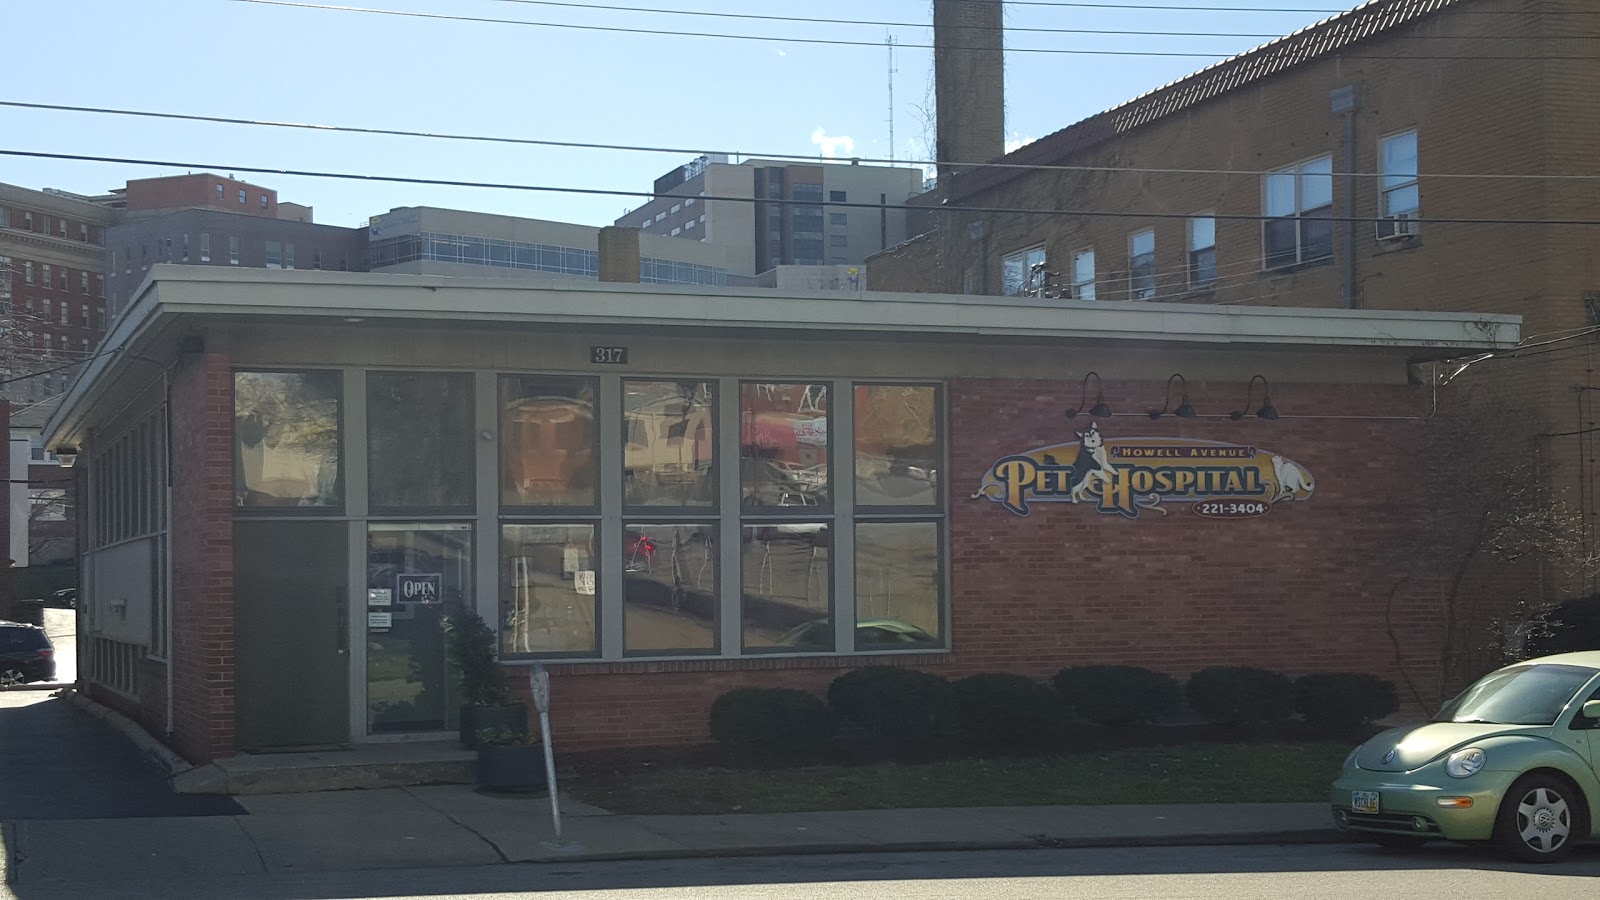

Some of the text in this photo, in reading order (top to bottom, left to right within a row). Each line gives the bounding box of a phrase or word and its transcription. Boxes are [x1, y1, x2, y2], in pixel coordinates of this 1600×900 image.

[595, 347, 623, 362] 317
[1122, 448, 1246, 457] HOWELL AVENUE
[996, 460, 1263, 511] PET HOSPITAL
[1202, 503, 1264, 514] 221-3404
[404, 580, 435, 597] OPEN
